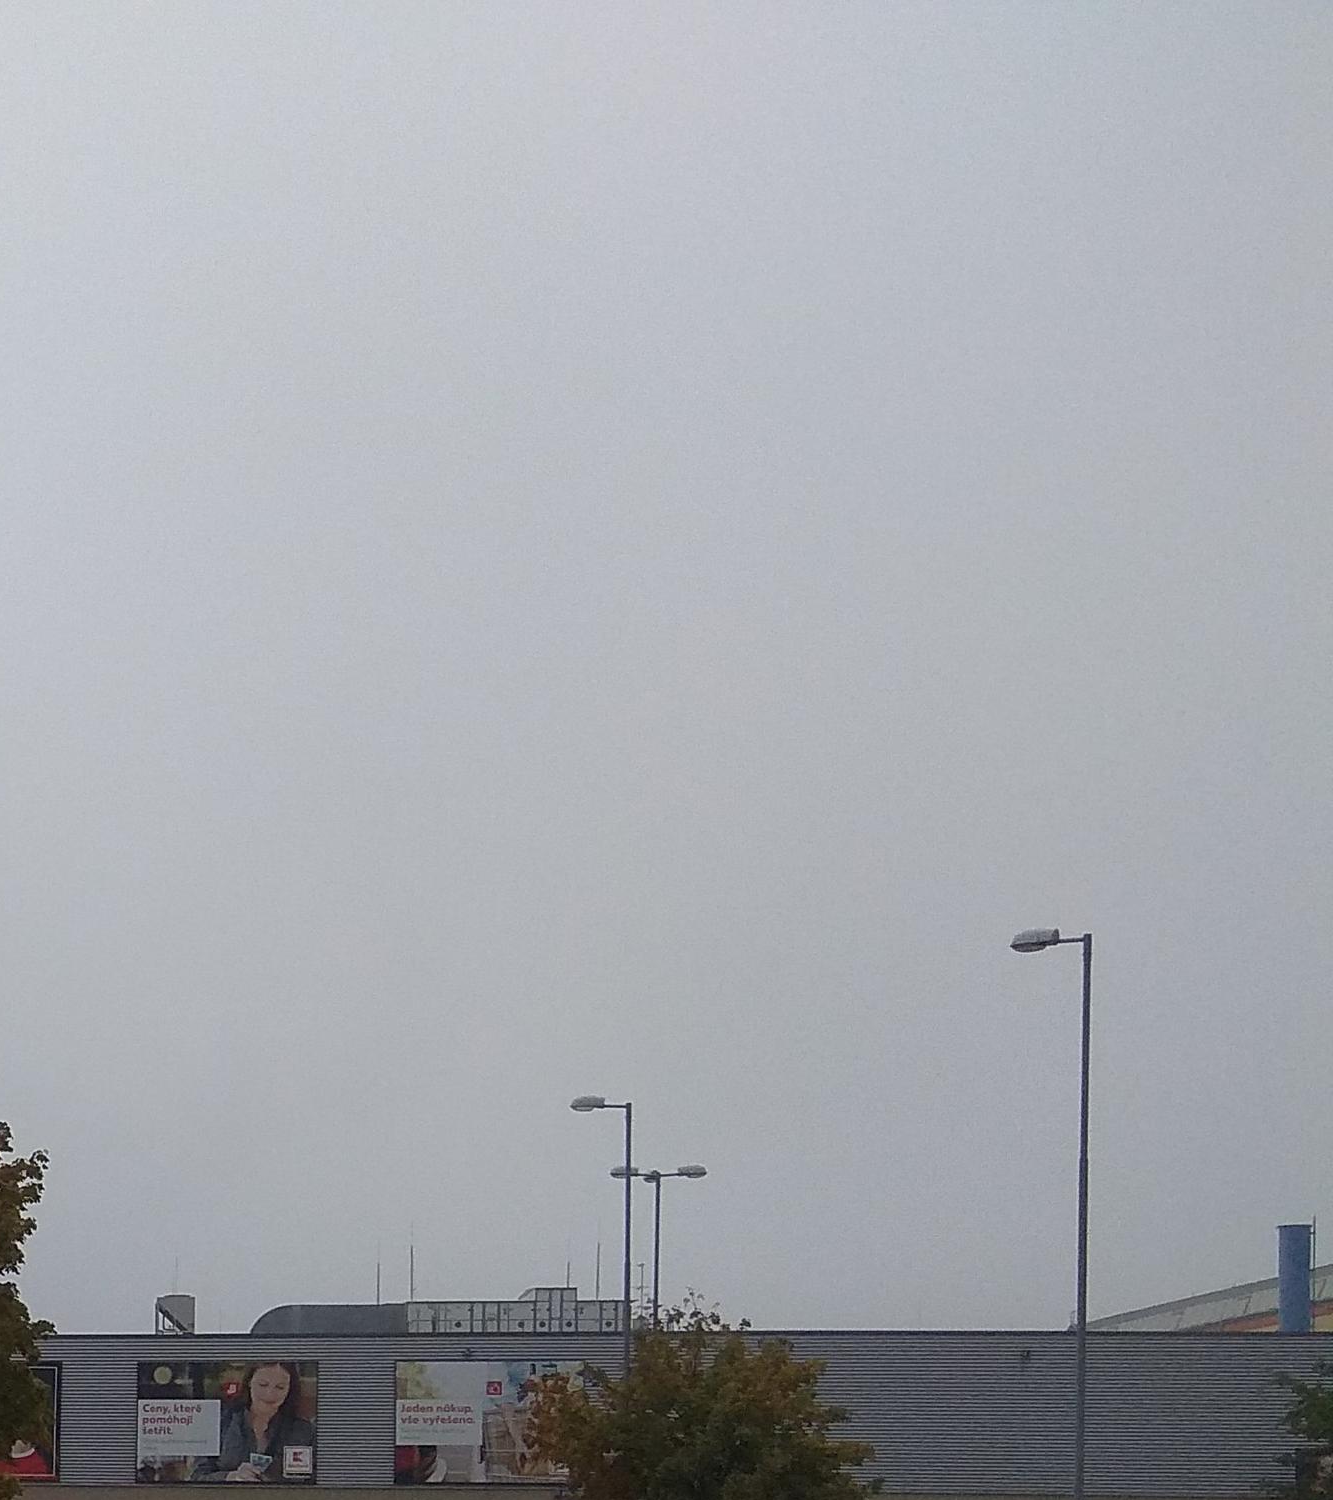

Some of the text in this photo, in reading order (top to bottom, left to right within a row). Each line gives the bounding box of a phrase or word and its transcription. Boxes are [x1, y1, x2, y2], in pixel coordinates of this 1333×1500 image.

[142, 1403, 202, 1414] Ceny, které
[401, 1403, 433, 1413] Jeden
